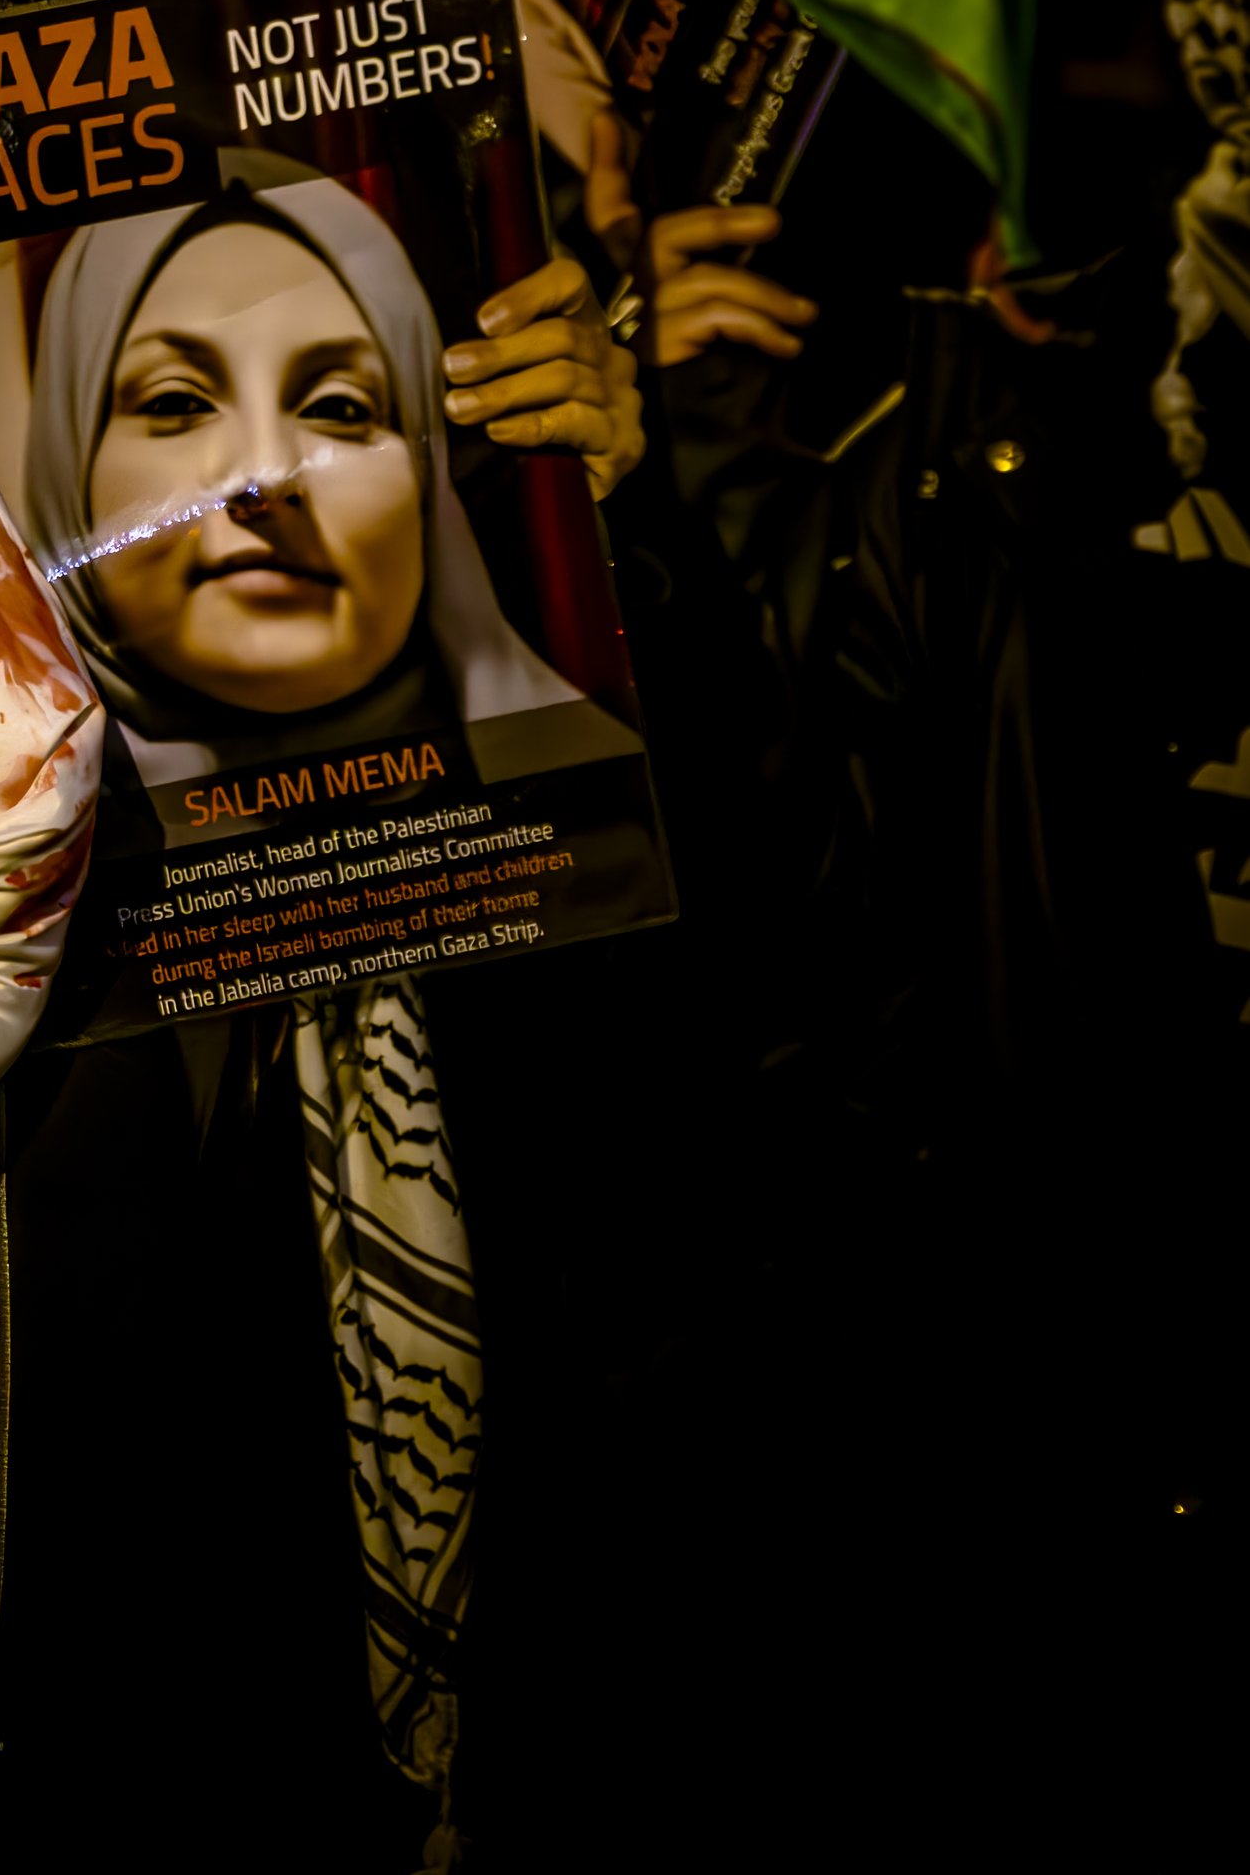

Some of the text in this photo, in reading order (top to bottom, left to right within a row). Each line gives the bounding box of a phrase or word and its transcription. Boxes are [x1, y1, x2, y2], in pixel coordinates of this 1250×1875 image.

[227, 13, 322, 74] NOT
[234, 32, 497, 131] NUMBERS!
[184, 741, 446, 827] SALAM MEMA
[117, 822, 555, 928] Press Union's Women Journalists Committee
[163, 803, 493, 889] Journalist, head of the Palestinian
[151, 888, 541, 986] during the Israeli bombing of their home
[162, 928, 182, 951] in
[185, 923, 218, 947] her
[223, 913, 277, 942] sleep
[279, 899, 325, 931] with
[326, 893, 359, 916] her
[363, 872, 450, 910] husband
[452, 865, 494, 891] and
[495, 850, 575, 883] children
[157, 917, 546, 1017] in the Jabalia camp, northern Gaza Strip.
